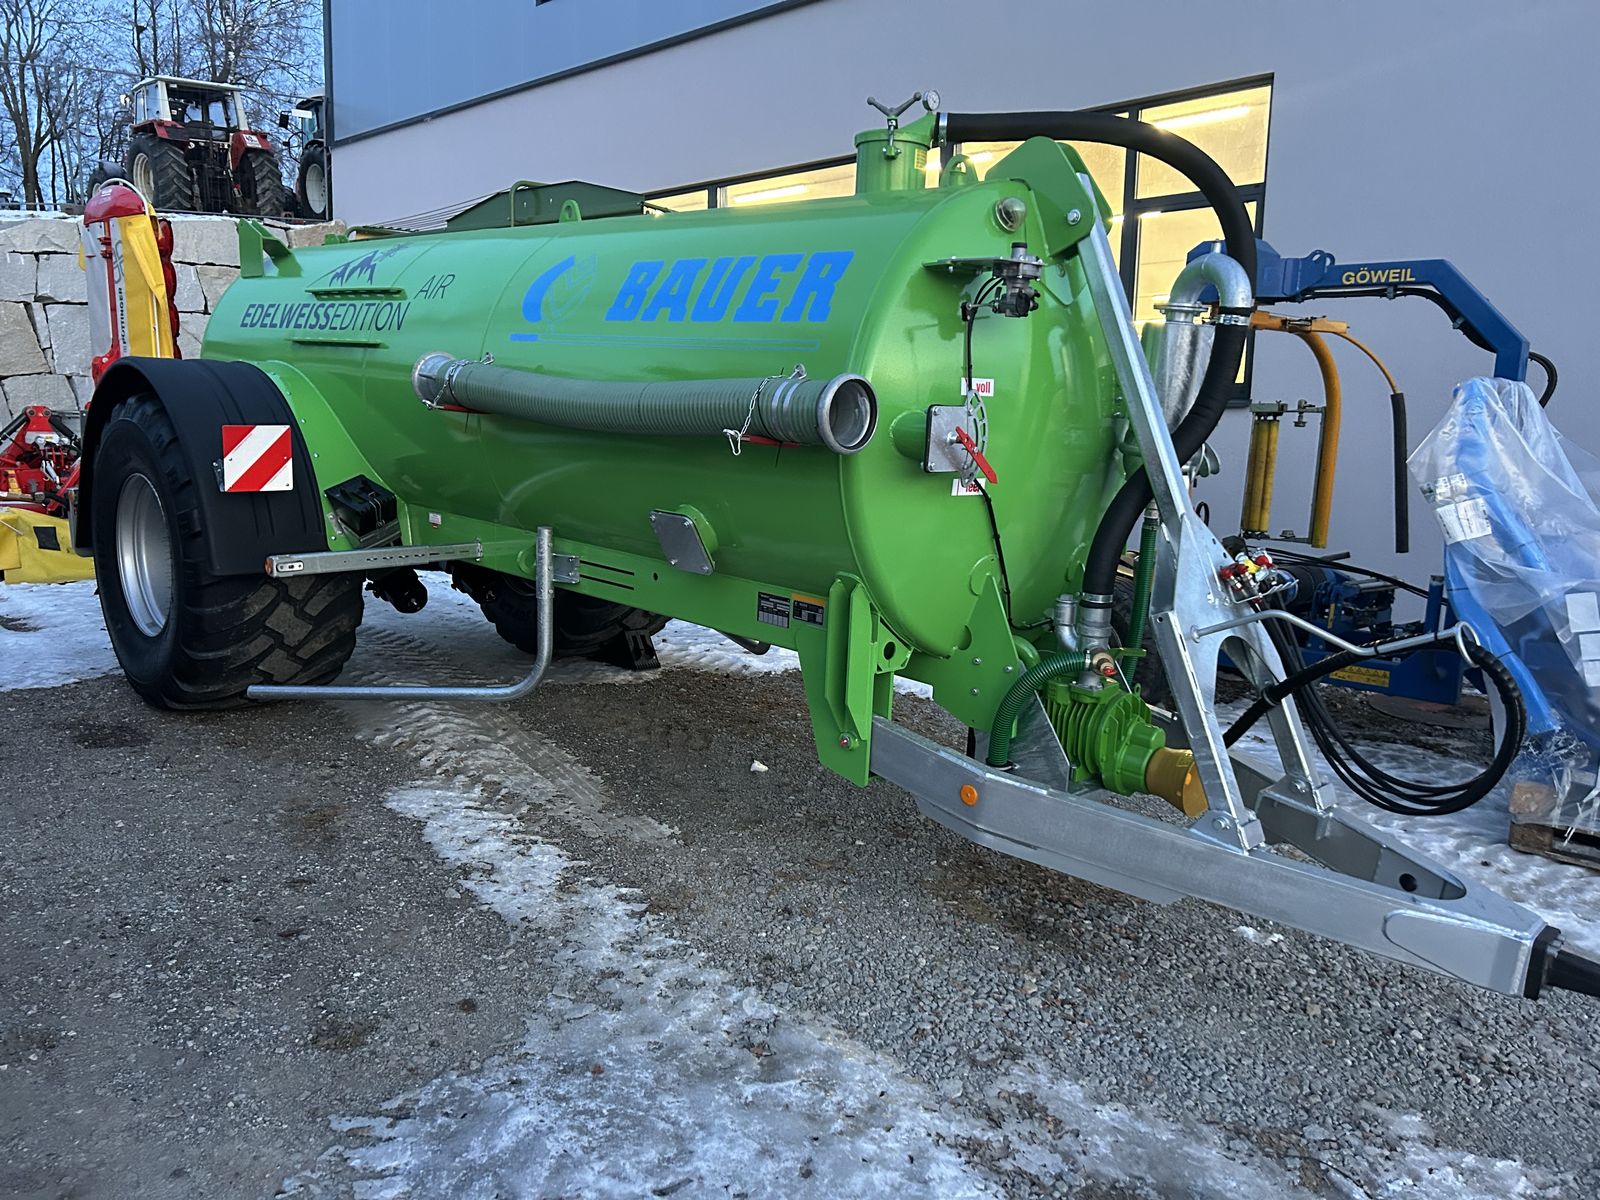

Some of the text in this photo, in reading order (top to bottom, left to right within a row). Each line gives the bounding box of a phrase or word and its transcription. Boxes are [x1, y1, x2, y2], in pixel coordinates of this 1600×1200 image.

[414, 274, 456, 300] AIR
[604, 250, 855, 323] BAUER
[1342, 267, 1416, 285] GÖWEIL
[239, 302, 411, 331] EDELWEISSEDITION
[975, 381, 991, 393] voll
